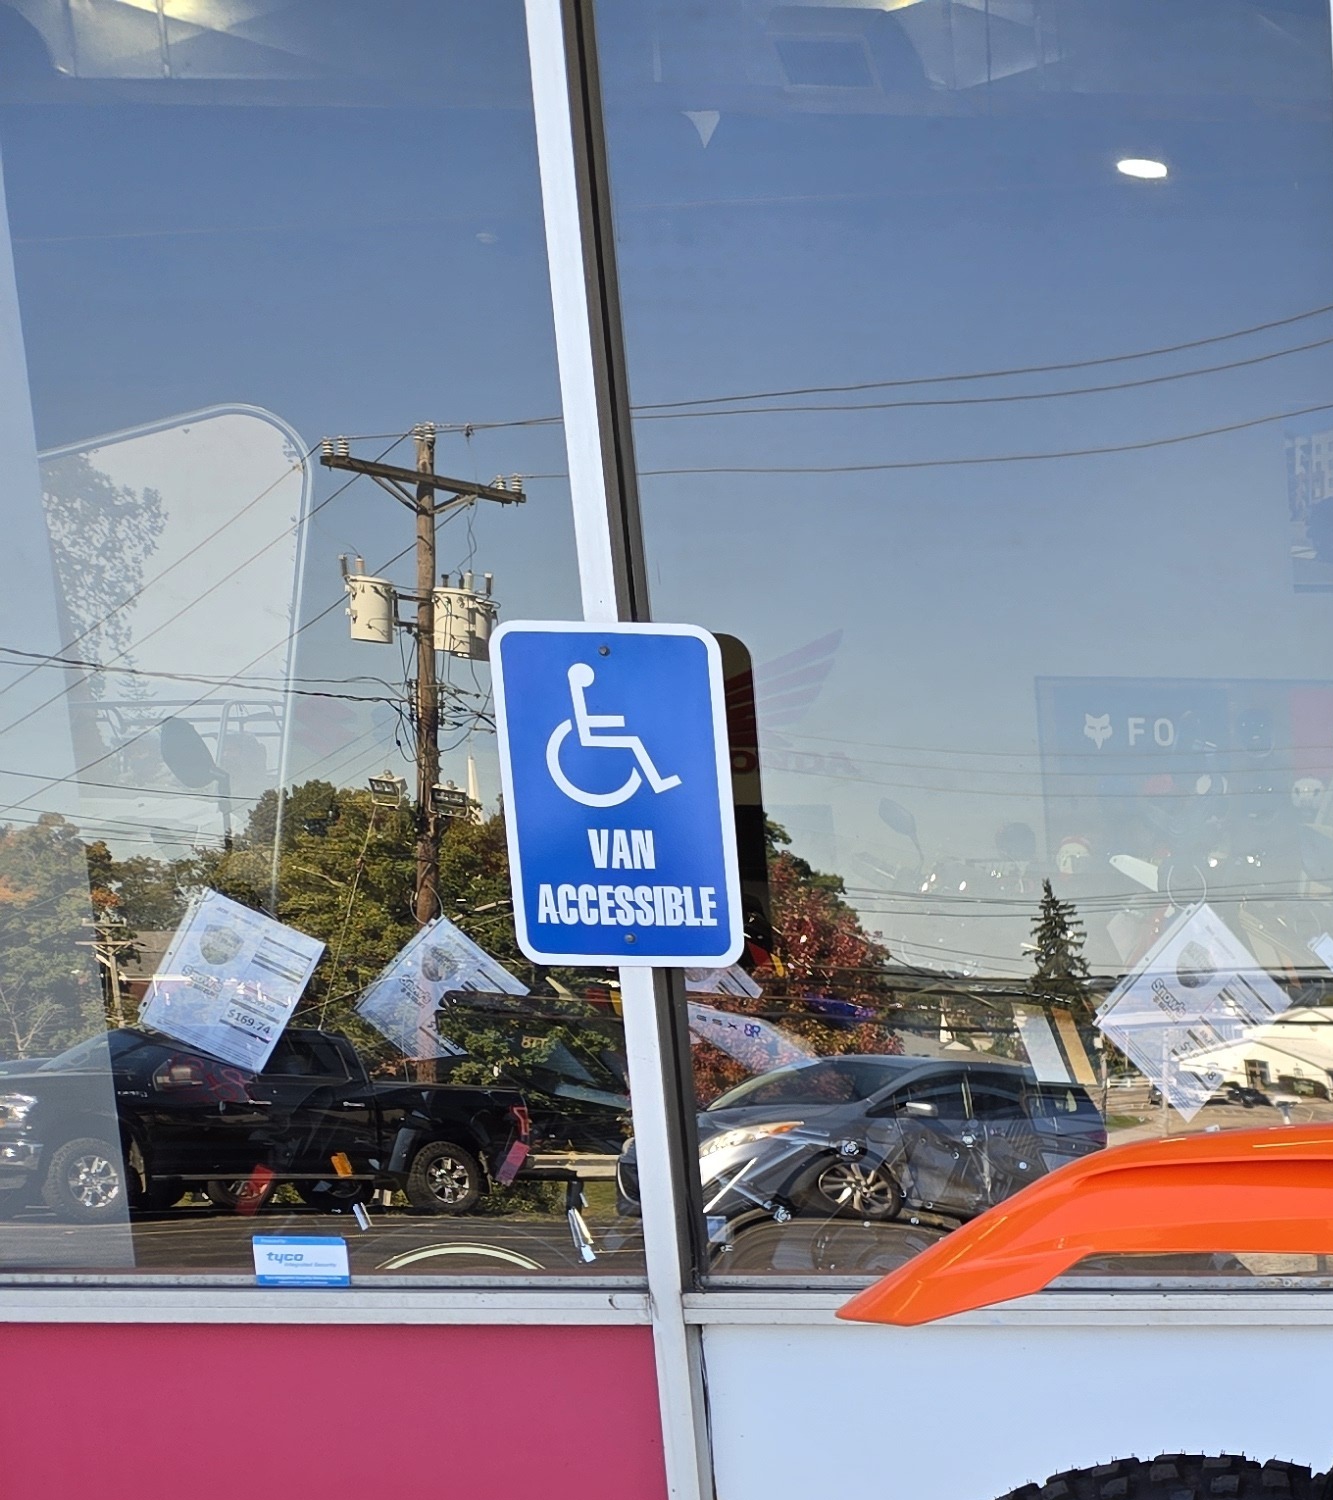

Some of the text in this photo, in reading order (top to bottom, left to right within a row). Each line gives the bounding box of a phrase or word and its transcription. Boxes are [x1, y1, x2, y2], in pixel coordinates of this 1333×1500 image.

[587, 829, 656, 869] VAN
[538, 884, 718, 927] ACCESSIBLE
[1148, 977, 1190, 1019] Snow's
[226, 1008, 271, 1037] $169.74
[266, 1252, 304, 1264] tyco
